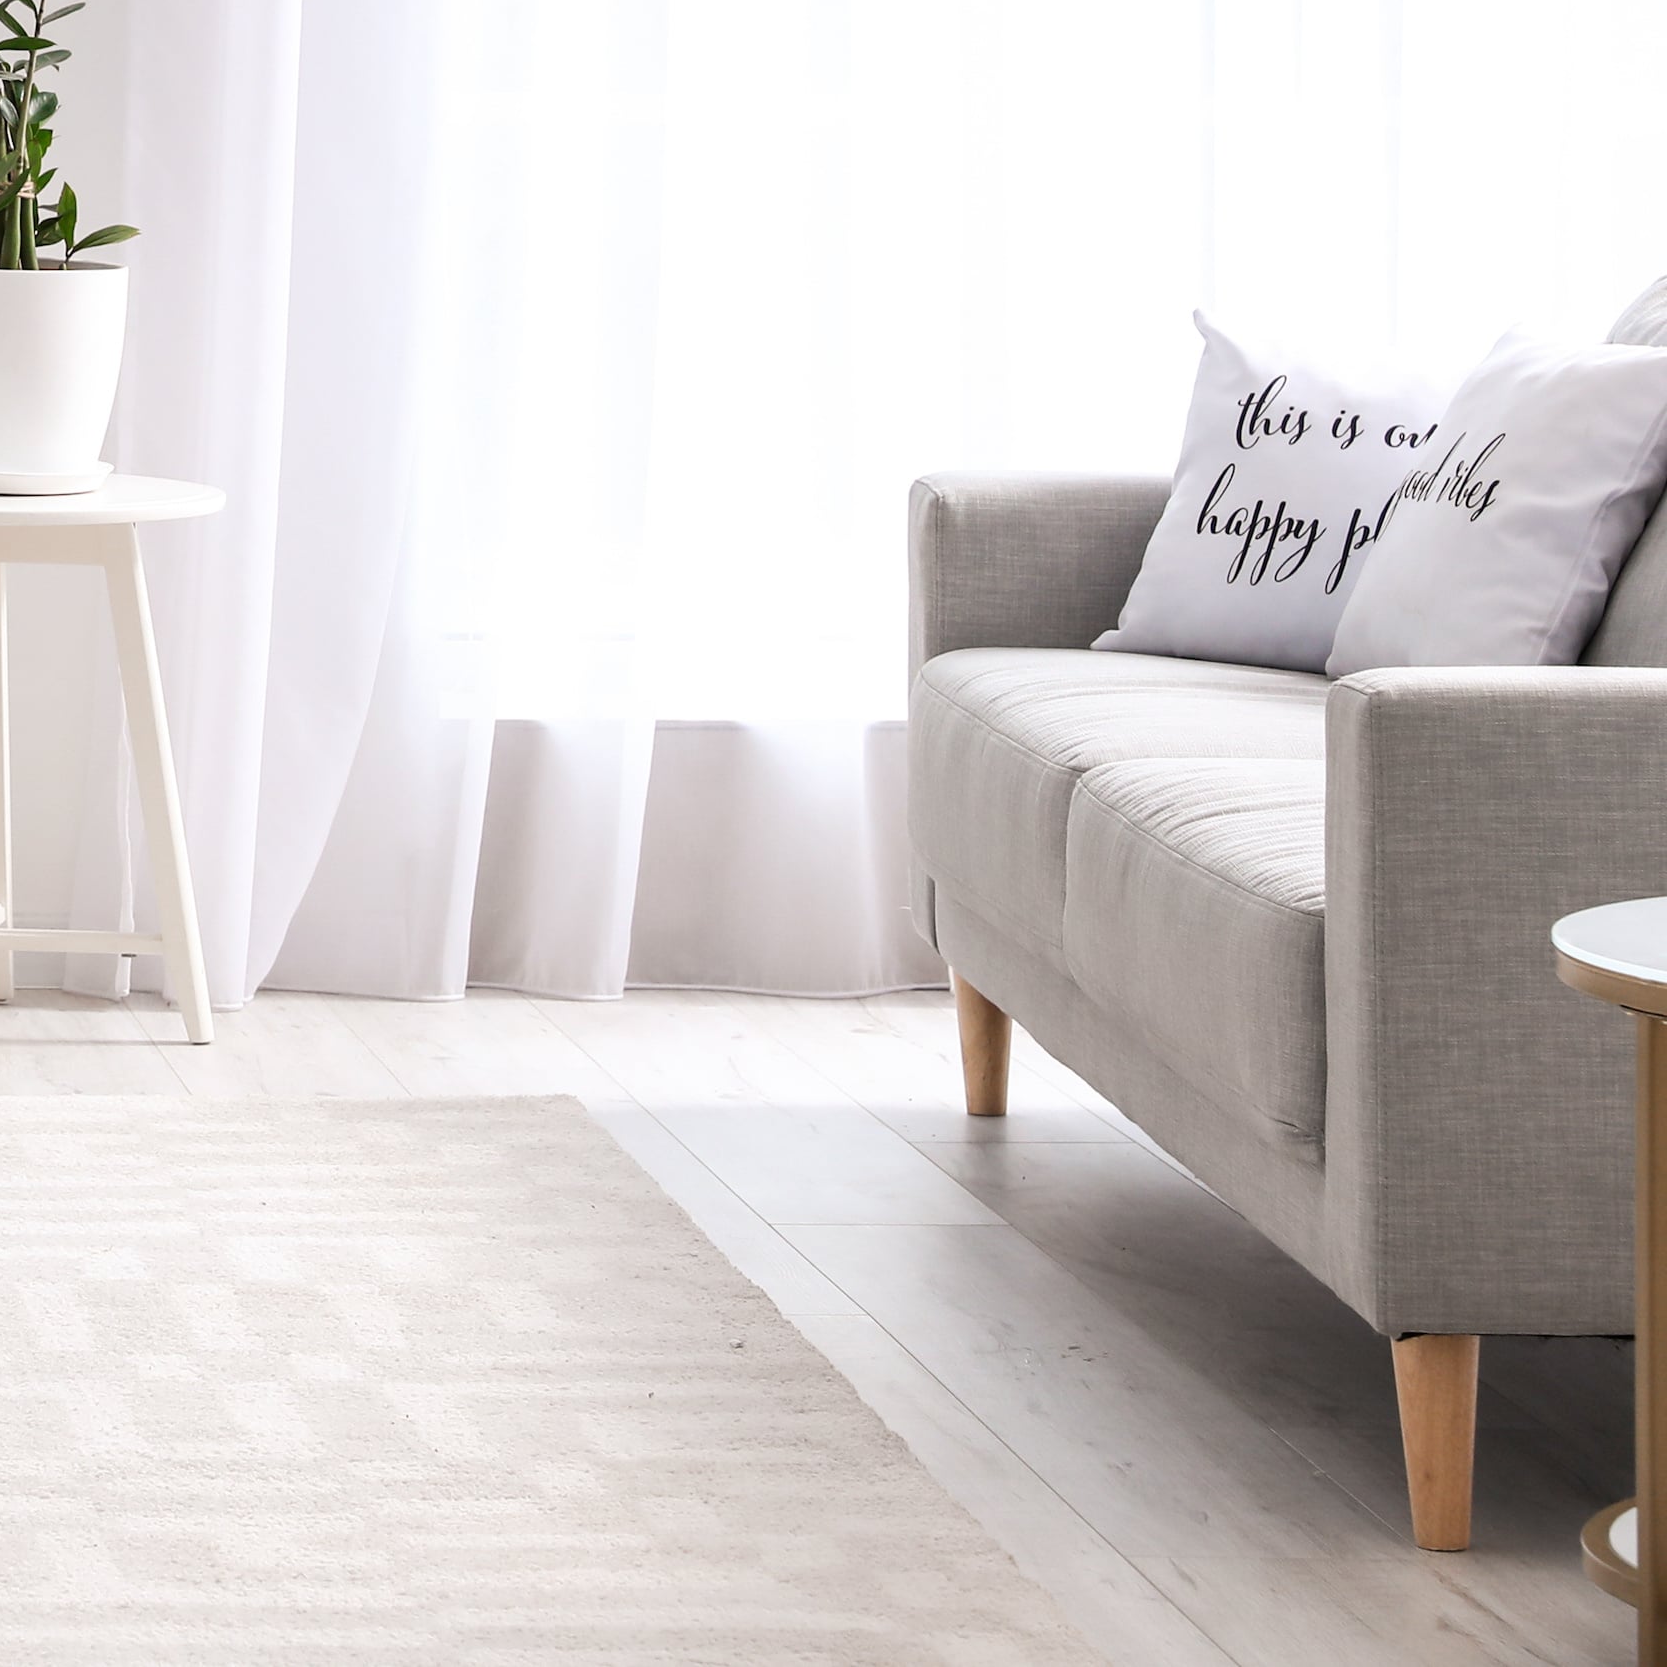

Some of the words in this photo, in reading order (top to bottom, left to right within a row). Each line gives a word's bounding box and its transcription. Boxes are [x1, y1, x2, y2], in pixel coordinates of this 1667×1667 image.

[1235, 374, 1313, 450] this
[1331, 409, 1365, 450] is
[1383, 423, 1439, 449] ou
[1196, 462, 1327, 586] happy
[1324, 487, 1400, 595] pl
